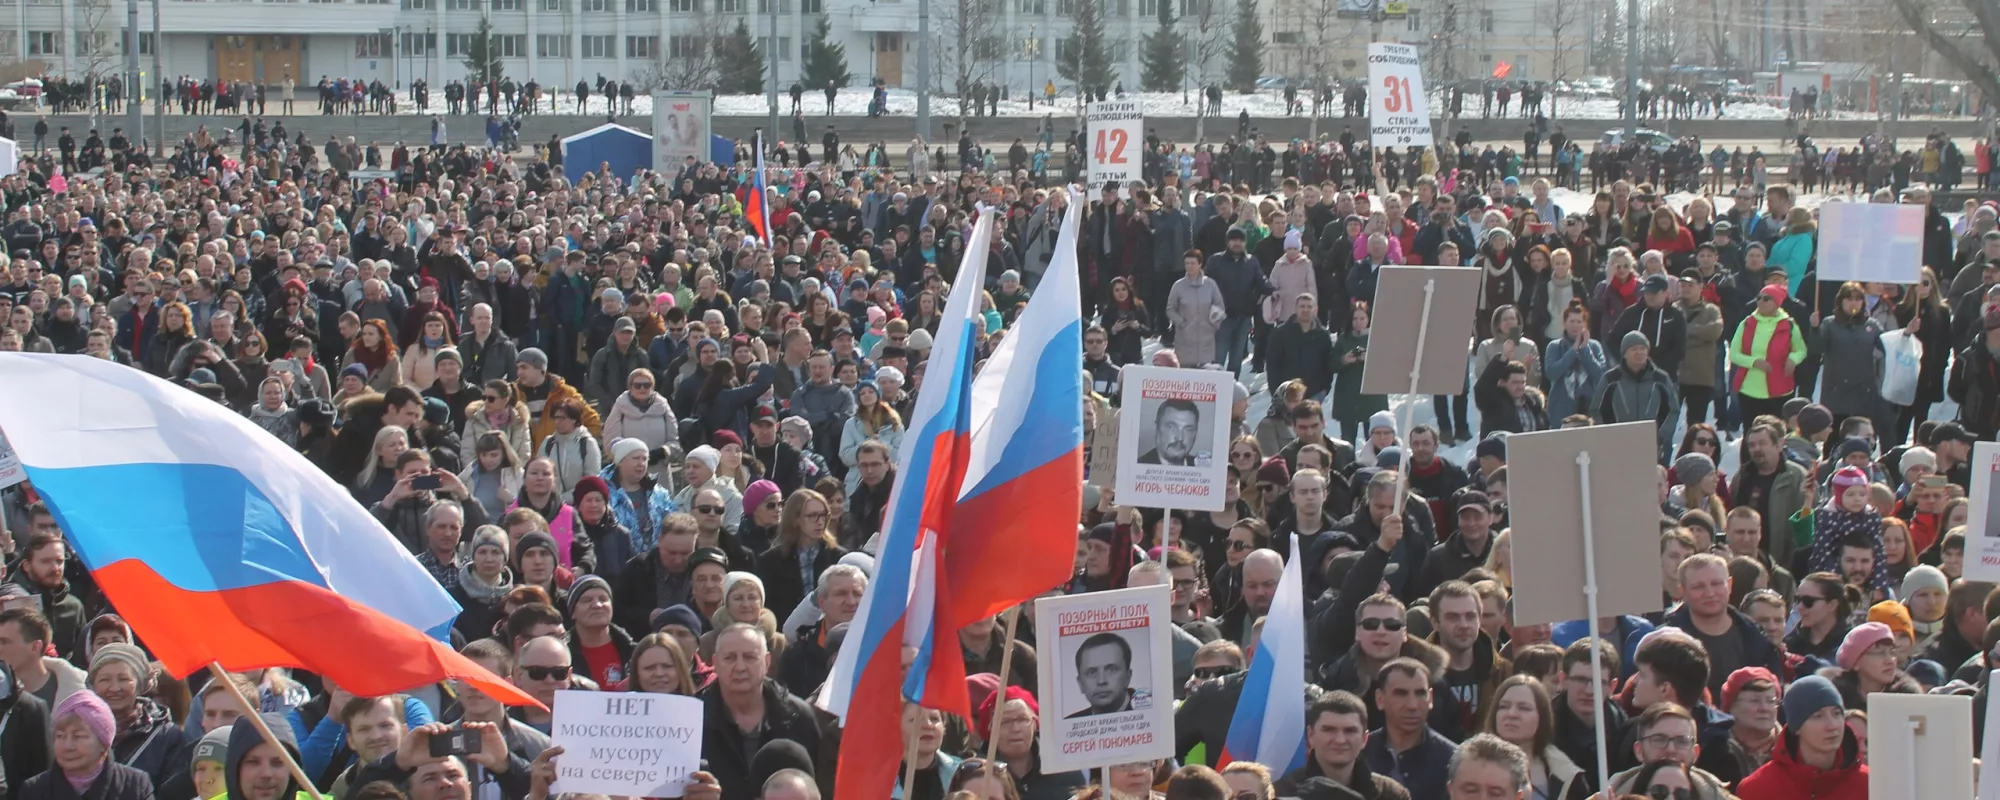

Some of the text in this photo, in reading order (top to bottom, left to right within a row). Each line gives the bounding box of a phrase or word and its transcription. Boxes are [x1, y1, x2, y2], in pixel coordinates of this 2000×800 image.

[1383, 45, 1411, 54] ТРЕБУЕМ
[1368, 55, 1418, 65] СОБЛЮДЕНИЯ
[1384, 75, 1413, 113] 31
[1096, 103, 1134, 112] ТРЕБУЕМ
[1088, 112, 1143, 122] СОБЛЮДЕНИЯ
[1388, 117, 1418, 125] СТАТЬИ
[1372, 126, 1431, 135] КОНСТИТУЦИИ
[1094, 128, 1128, 165] 42
[1397, 136, 1411, 144] РФ
[1095, 172, 1127, 180] СТАТЬИ
[1142, 379, 1217, 393] ПОЗОРНЫЙ ПОЛК
[1145, 390, 1175, 399] ВЛАСТЬ
[1182, 393, 1212, 401] ОТВЕТУ!
[1135, 481, 1210, 496] ИГОРЬ ЧЕСНОКОВ
[1058, 603, 1149, 625] ПОЗОРНЫЙ ПОЛК
[1063, 618, 1146, 635] ВЛАСТЬ К ОТВЕТУ!
[606, 698, 655, 716] НЕТ
[1072, 713, 1144, 730] ДЕПУТАТ АРХАНГЕЛЬСКОЙ
[560, 723, 695, 744] московскому
[1066, 727, 1098, 738] ГОРОДСКОЙ
[1063, 732, 1153, 754] СЕРГЕЙ ПОНОМАРЕВ
[589, 747, 664, 766] мусору
[561, 766, 686, 786] на севере !!!
